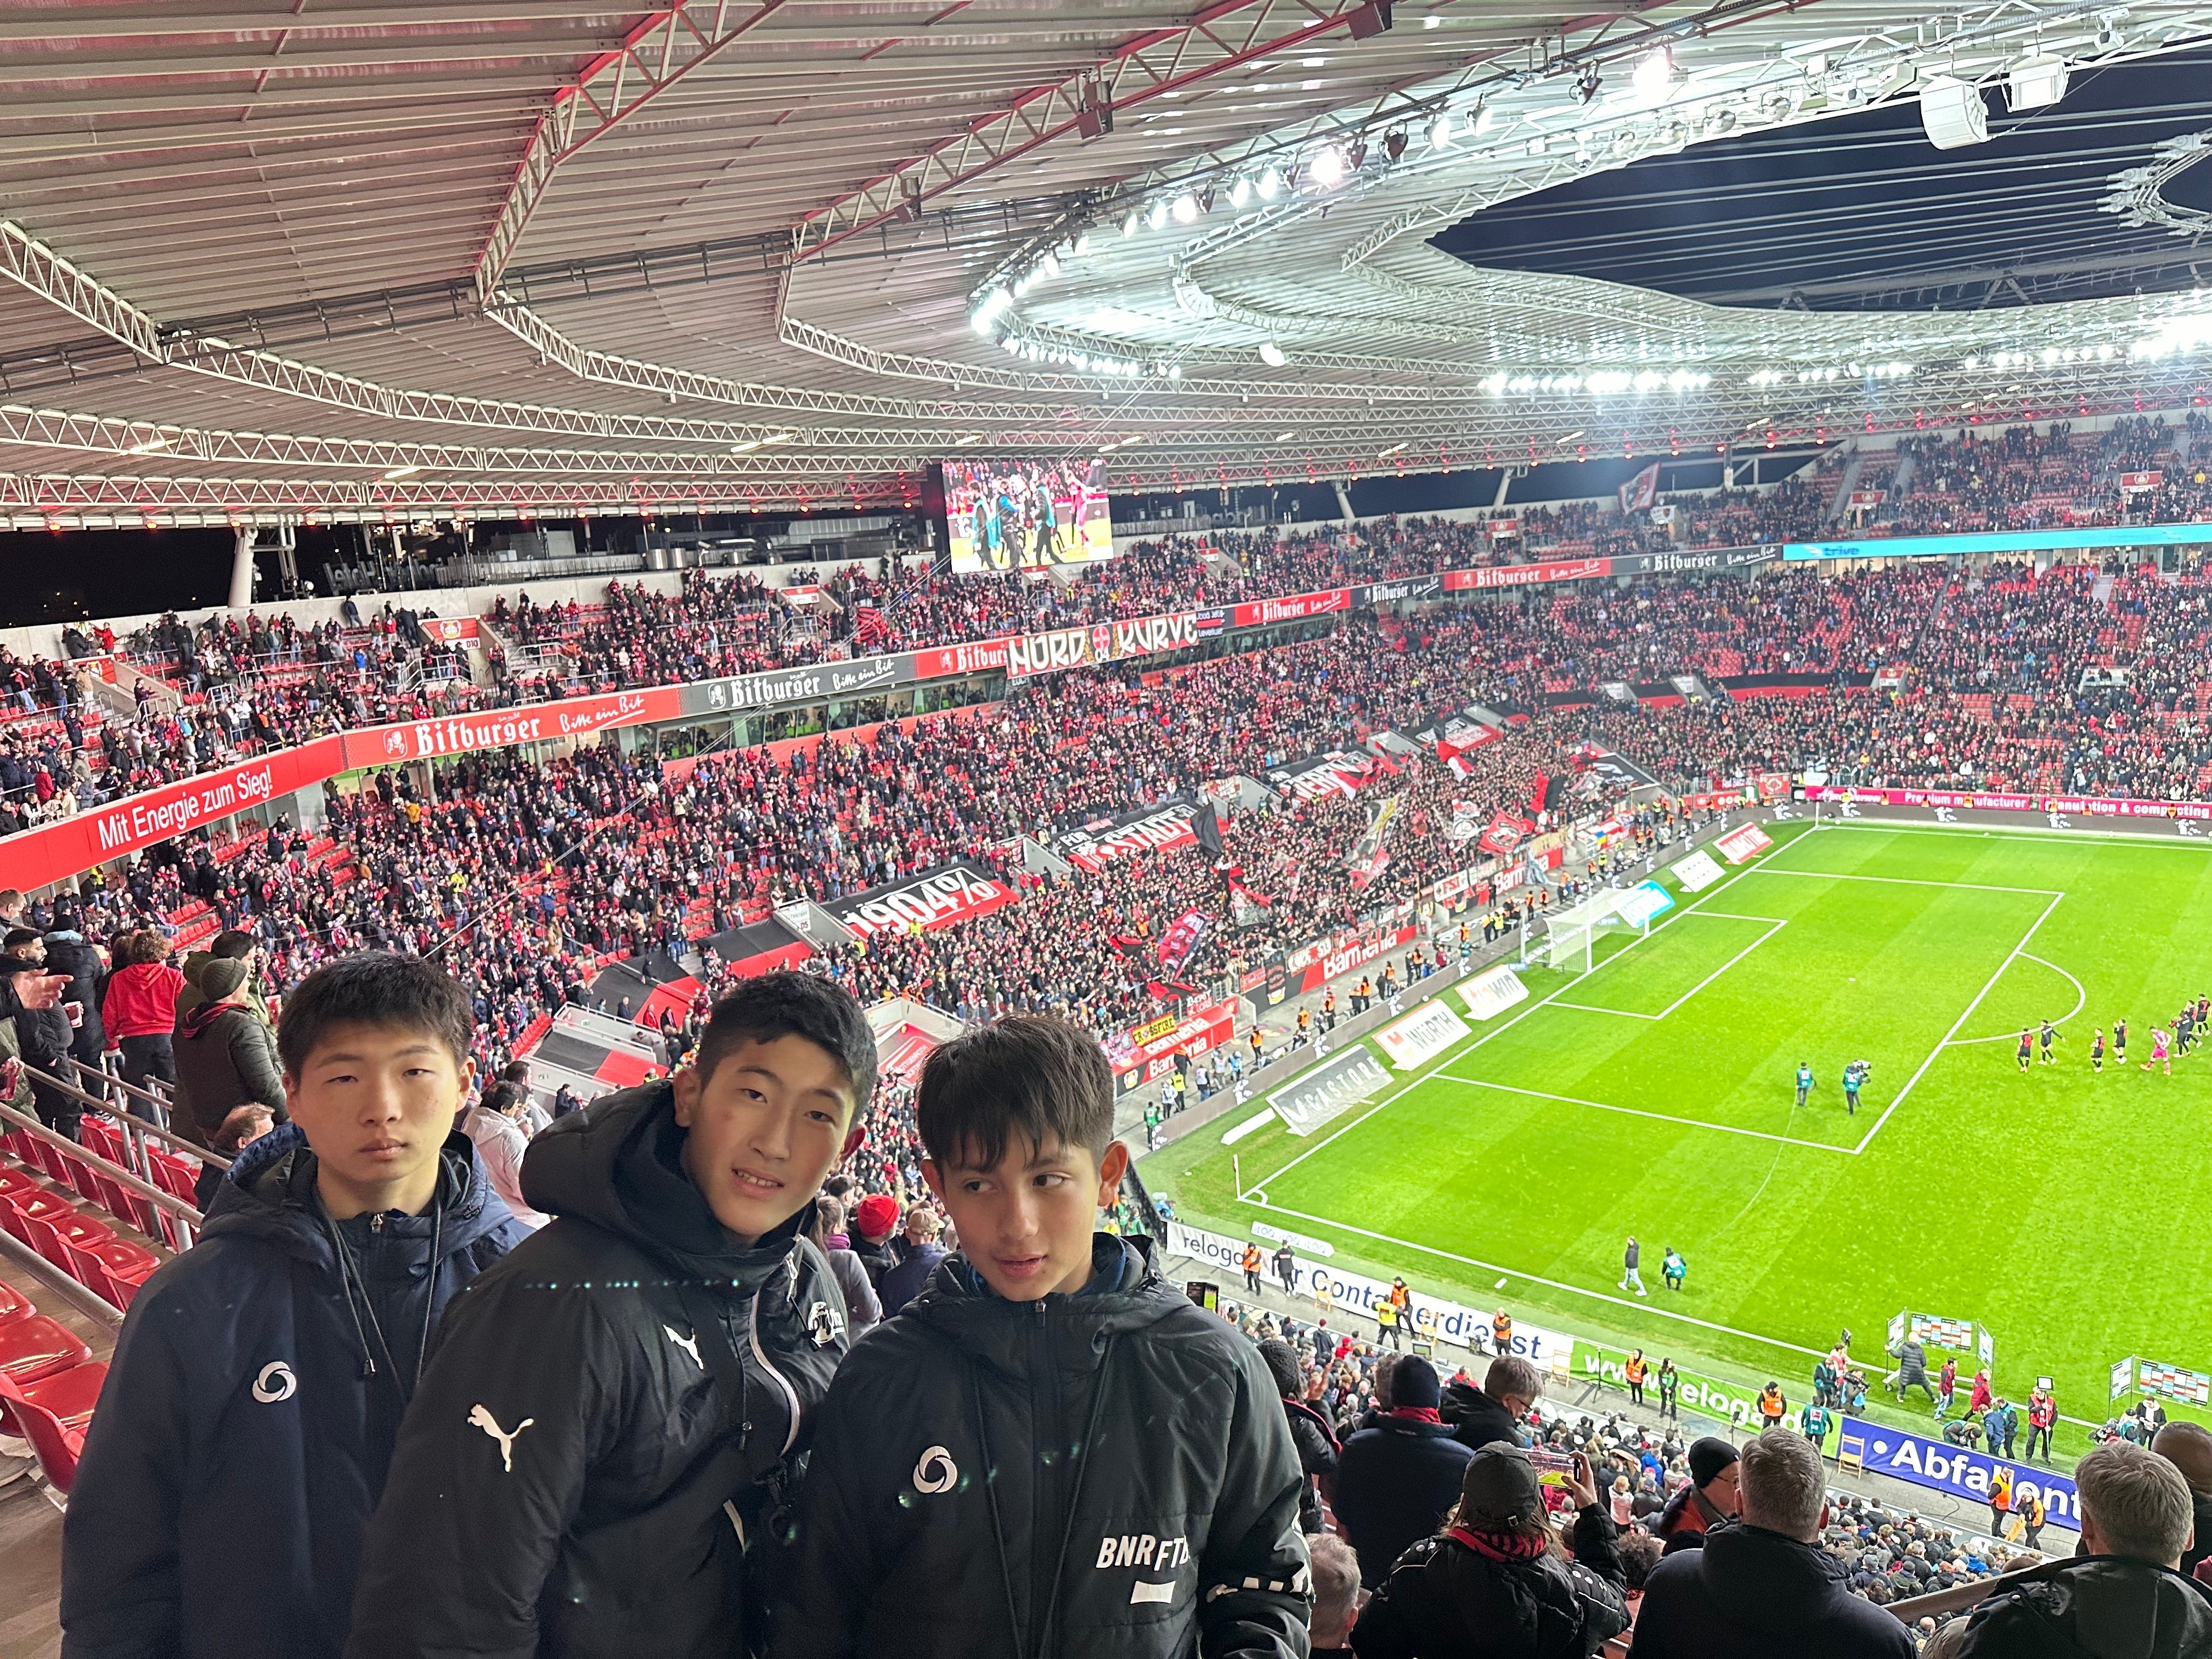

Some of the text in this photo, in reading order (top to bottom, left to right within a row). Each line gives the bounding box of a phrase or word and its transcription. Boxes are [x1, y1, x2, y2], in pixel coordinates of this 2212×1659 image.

[1476, 568, 1541, 586] Bitburger
[1654, 554, 1717, 571] Bitburger
[1262, 601, 1305, 621] Bitburger
[1372, 584, 1408, 602] Bitburger
[957, 643, 1008, 671] Bitburg
[1008, 629, 1087, 676] NORD
[1116, 613, 1198, 654] KURVE
[730, 676, 821, 707] Bitburger
[416, 715, 540, 757] Bitburger
[559, 713, 593, 733] Bitte
[595, 705, 619, 725] ein
[619, 693, 645, 715] Bit
[98, 764, 273, 850] Mit Energie zum Sieg!
[1904, 792, 2027, 808] Preium mufacturer
[2044, 799, 2210, 818] ganultion & compcting
[1059, 831, 1092, 847] FÜR
[1494, 854, 1549, 895] Barma
[843, 869, 995, 934] 1904%
[1405, 1011, 1459, 1049] WÜRTH
[1149, 1036, 1207, 1078] Barnia
[1305, 1056, 1387, 1111] CASTORE
[1272, 1255, 1303, 1284] Ir
[1312, 1269, 1541, 1359] Conterdiest
[1890, 1440, 2081, 1521] Abfaent
